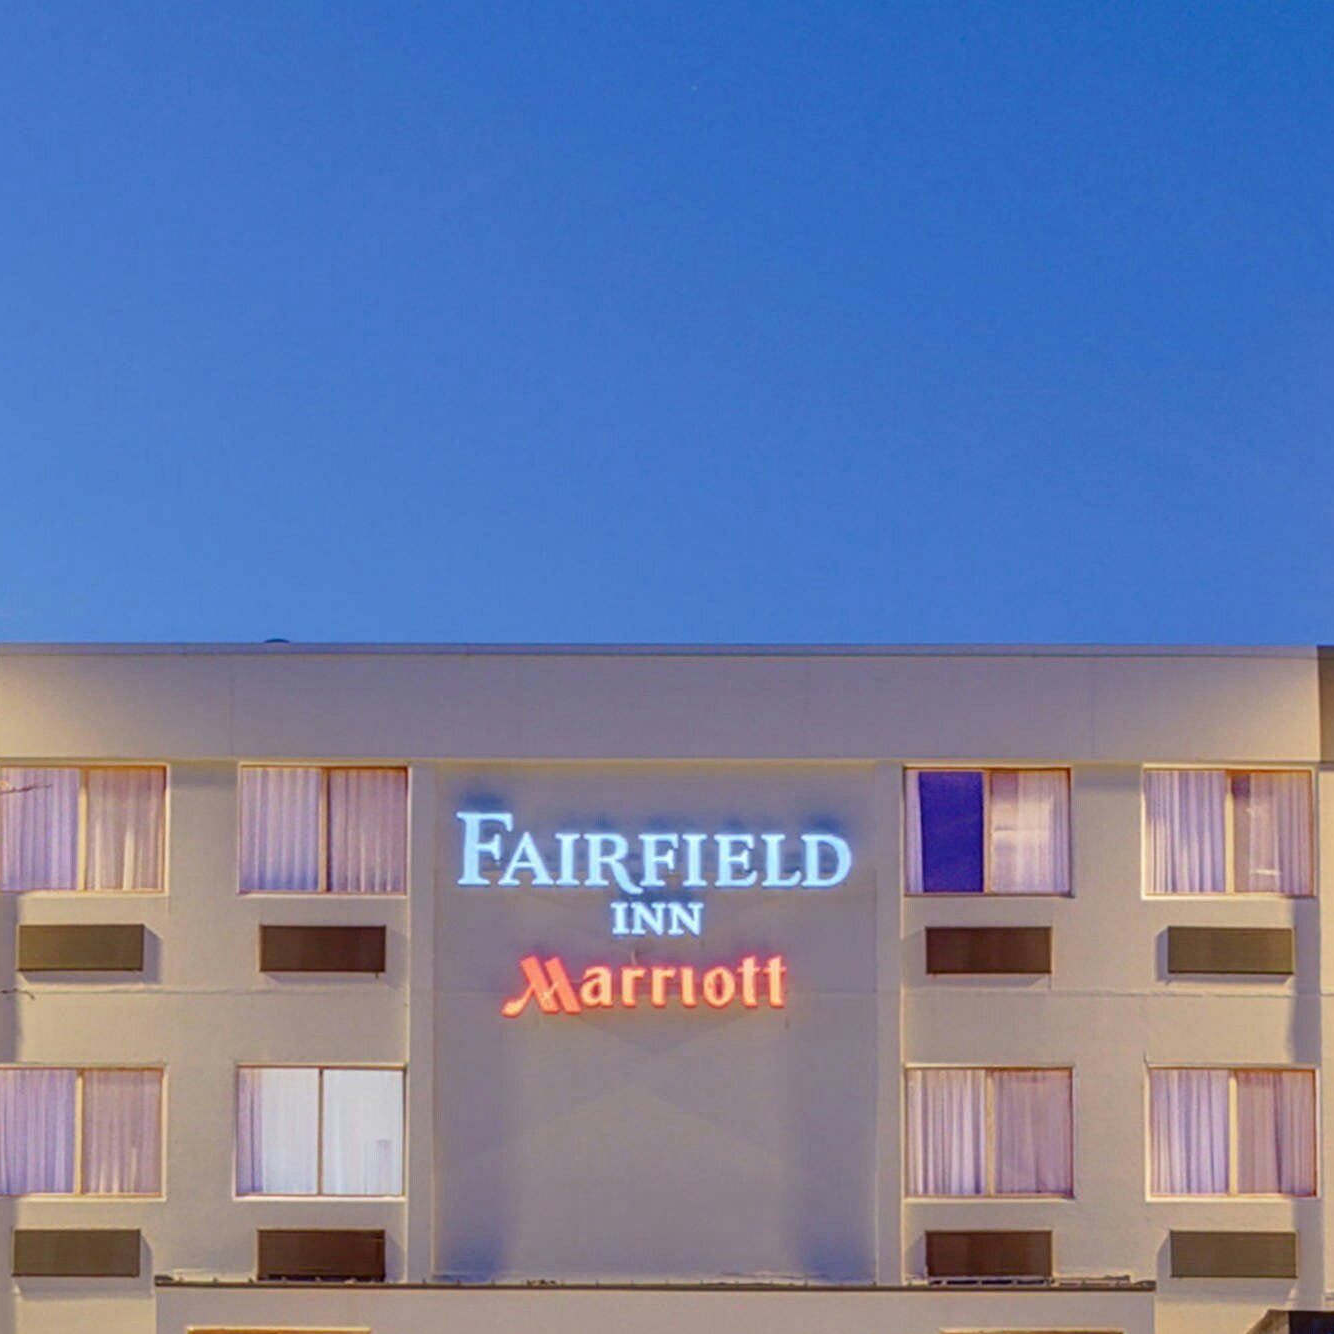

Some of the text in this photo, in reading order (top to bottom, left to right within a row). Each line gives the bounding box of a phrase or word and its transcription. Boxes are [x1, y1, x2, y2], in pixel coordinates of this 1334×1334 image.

[456, 811, 853, 894] FAIRFIELD
[611, 901, 705, 936] INN
[501, 954, 787, 1018] Marriott
